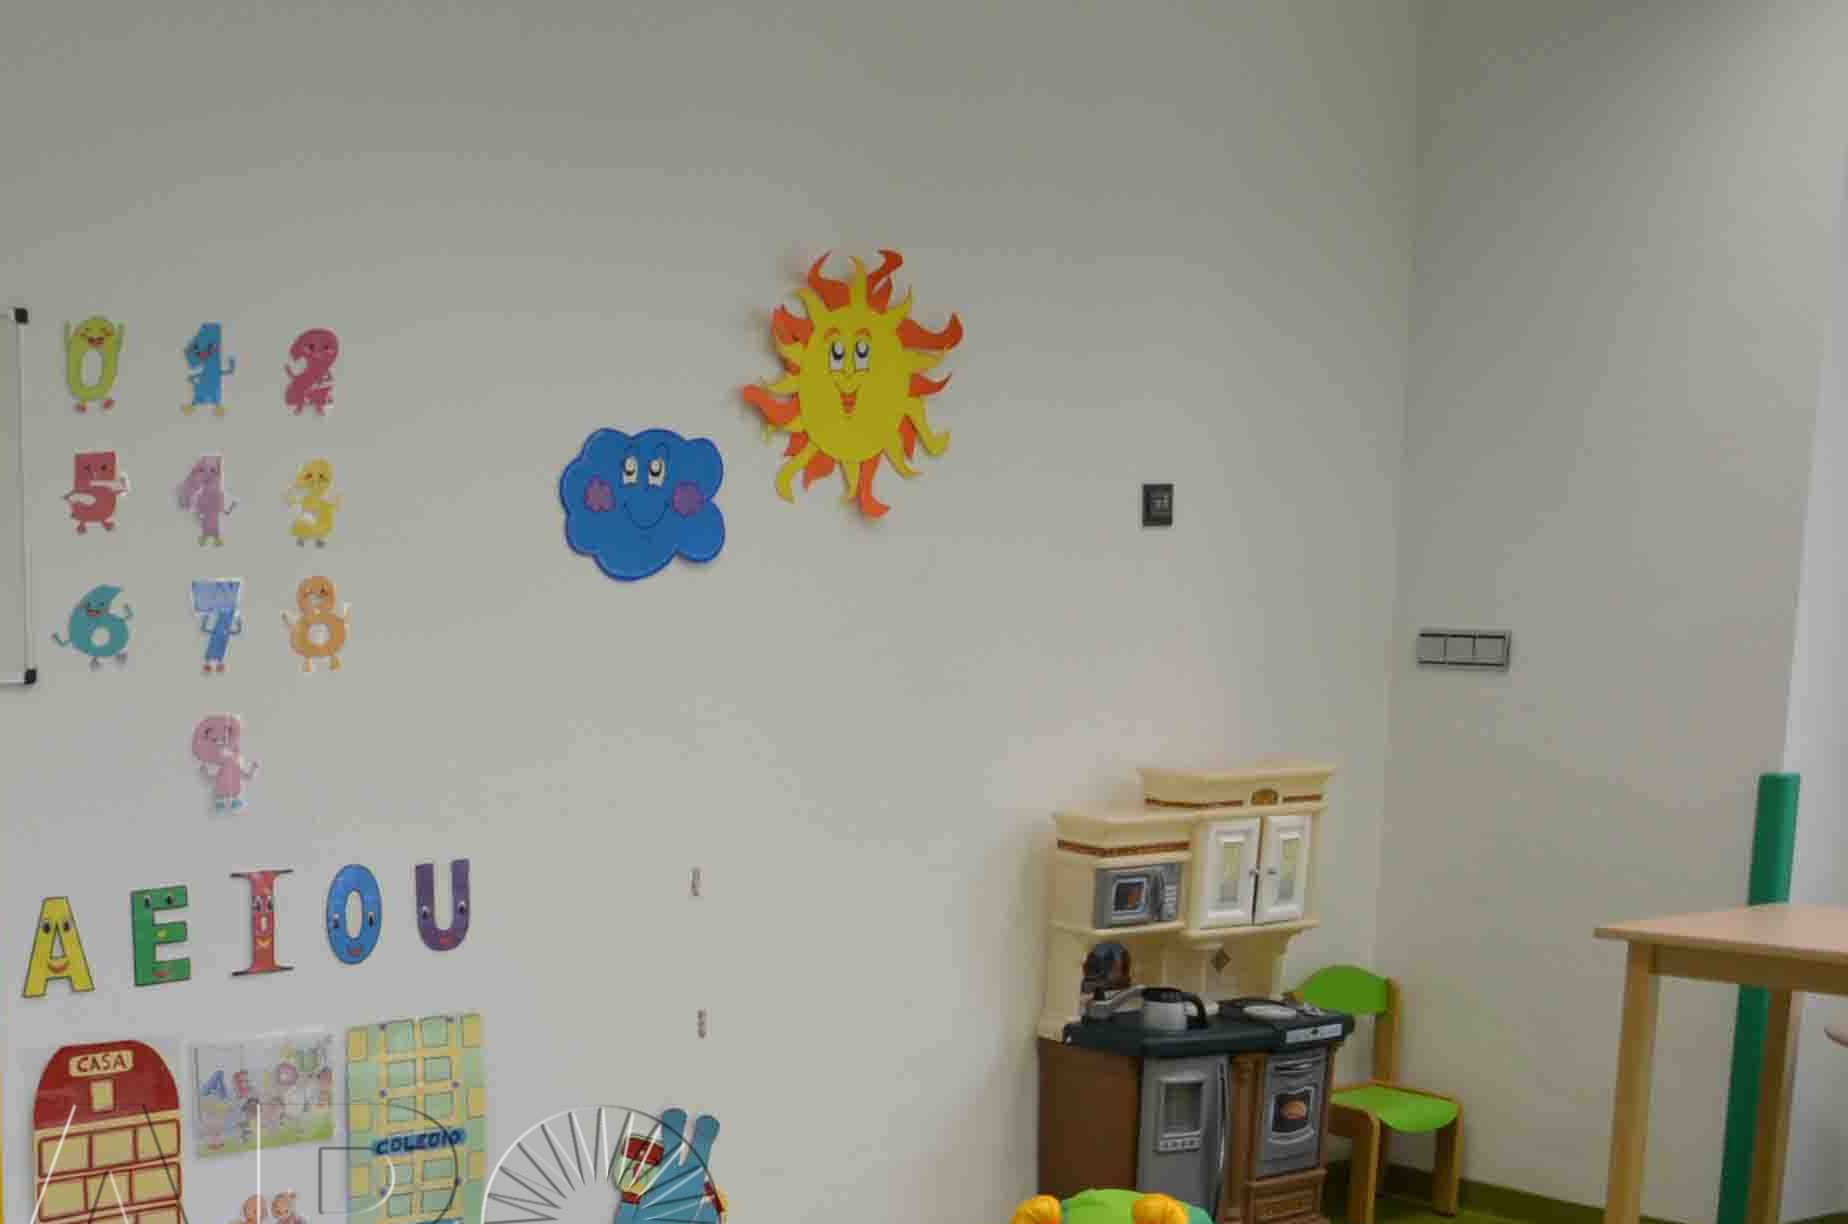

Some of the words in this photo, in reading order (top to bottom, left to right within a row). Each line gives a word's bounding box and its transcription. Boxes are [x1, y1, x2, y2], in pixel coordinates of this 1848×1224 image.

[63, 315, 125, 412] 0
[181, 321, 236, 416] 1
[283, 327, 340, 415] 2
[190, 578, 243, 674] 7
[282, 575, 351, 673] 8
[76, 1053, 129, 1073] CASA
